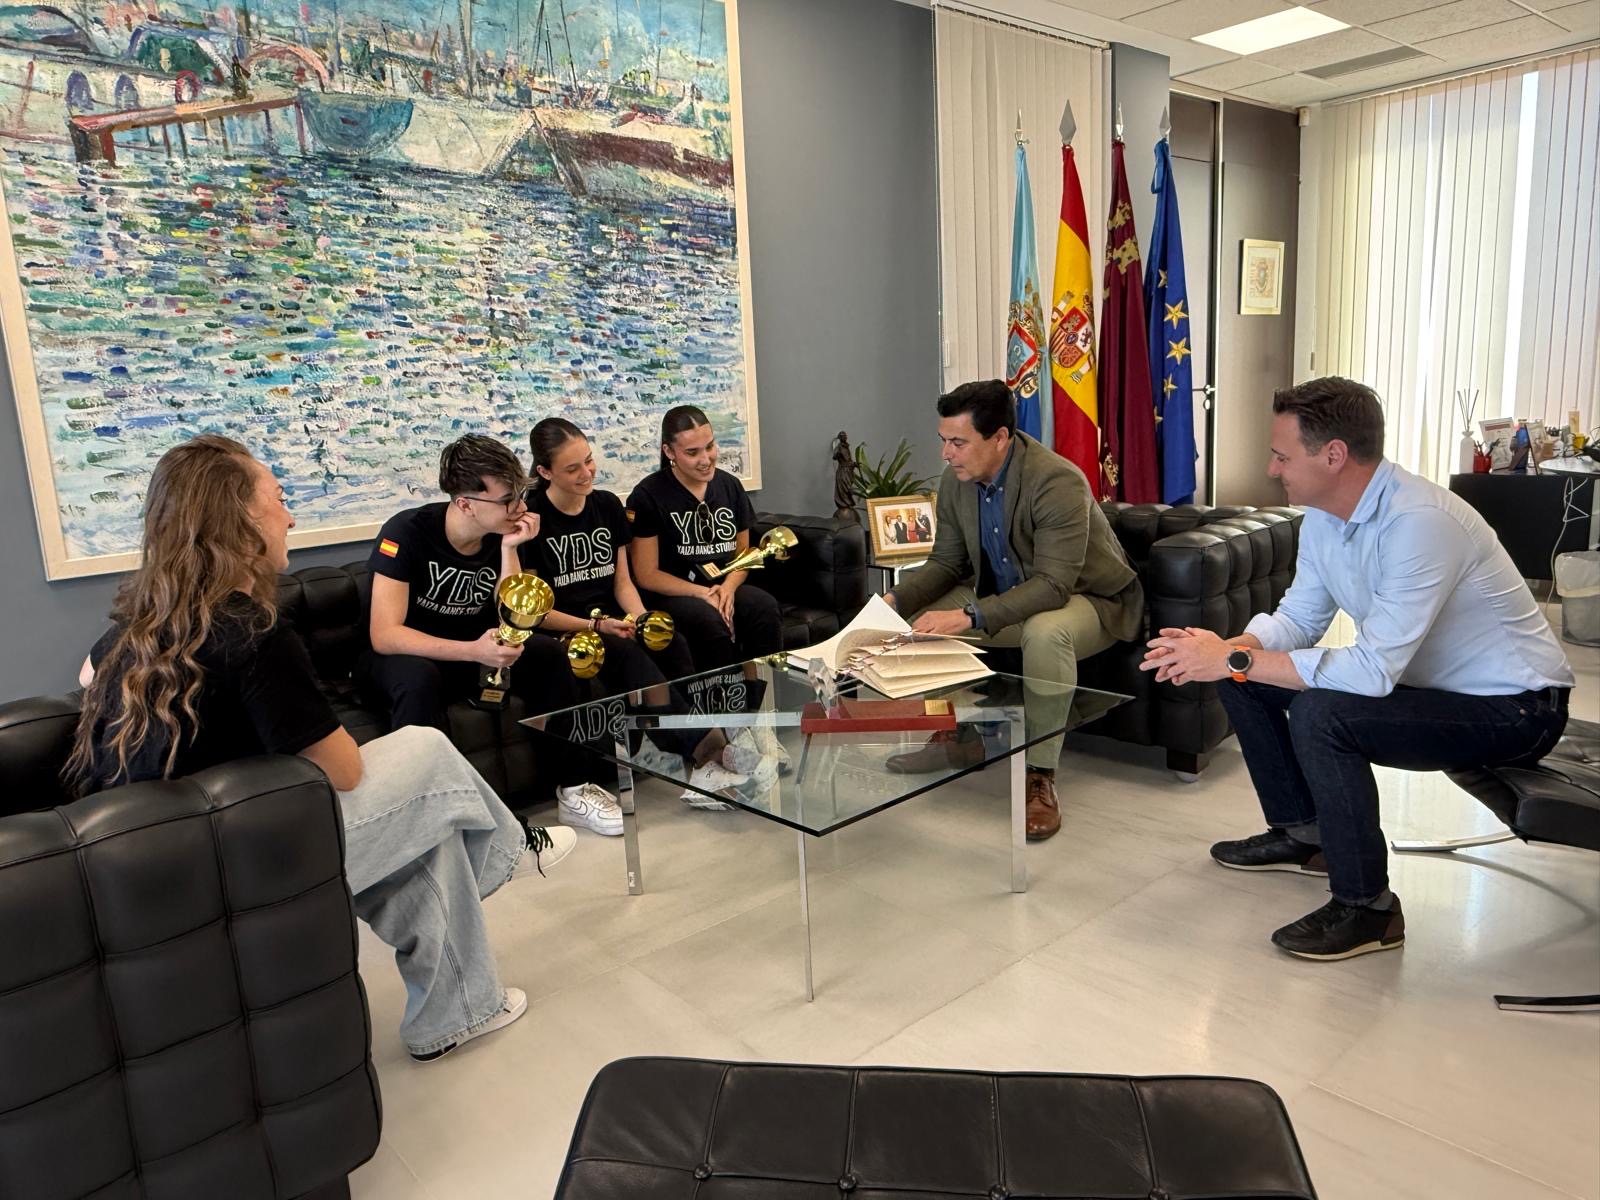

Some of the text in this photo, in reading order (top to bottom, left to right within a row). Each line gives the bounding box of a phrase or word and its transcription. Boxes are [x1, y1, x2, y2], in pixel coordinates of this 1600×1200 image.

[546, 527, 613, 574] YDS
[676, 544, 695, 556] YAIZA
[695, 543, 716, 555] DANCE
[426, 561, 497, 606] YDS
[553, 563, 615, 588] YAIZA DANCE STUDIOS
[416, 595, 439, 612] YAIZA
[439, 605, 466, 616] DANCE
